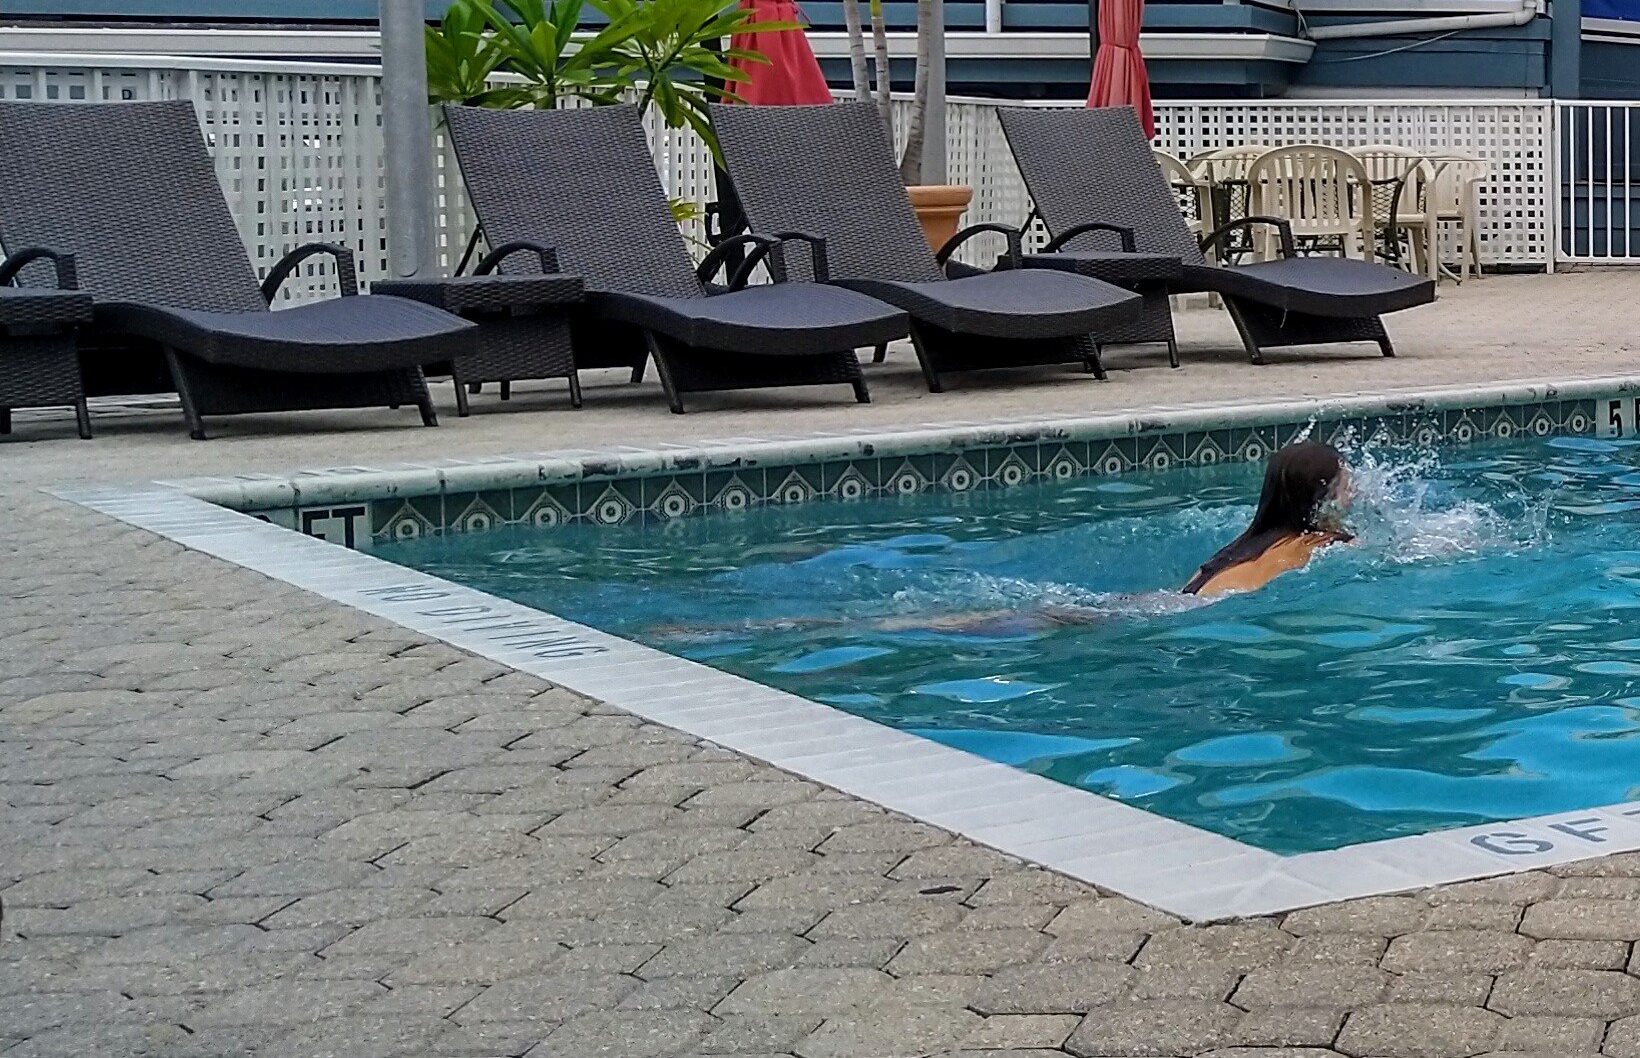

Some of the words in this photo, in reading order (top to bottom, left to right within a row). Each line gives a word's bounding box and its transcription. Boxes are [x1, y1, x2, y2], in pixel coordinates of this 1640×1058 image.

[1609, 400, 1623, 438] 5
[302, 506, 365, 550] FT
[357, 584, 451, 602] NO
[415, 606, 609, 658] DIVING
[1470, 831, 1554, 855] 6
